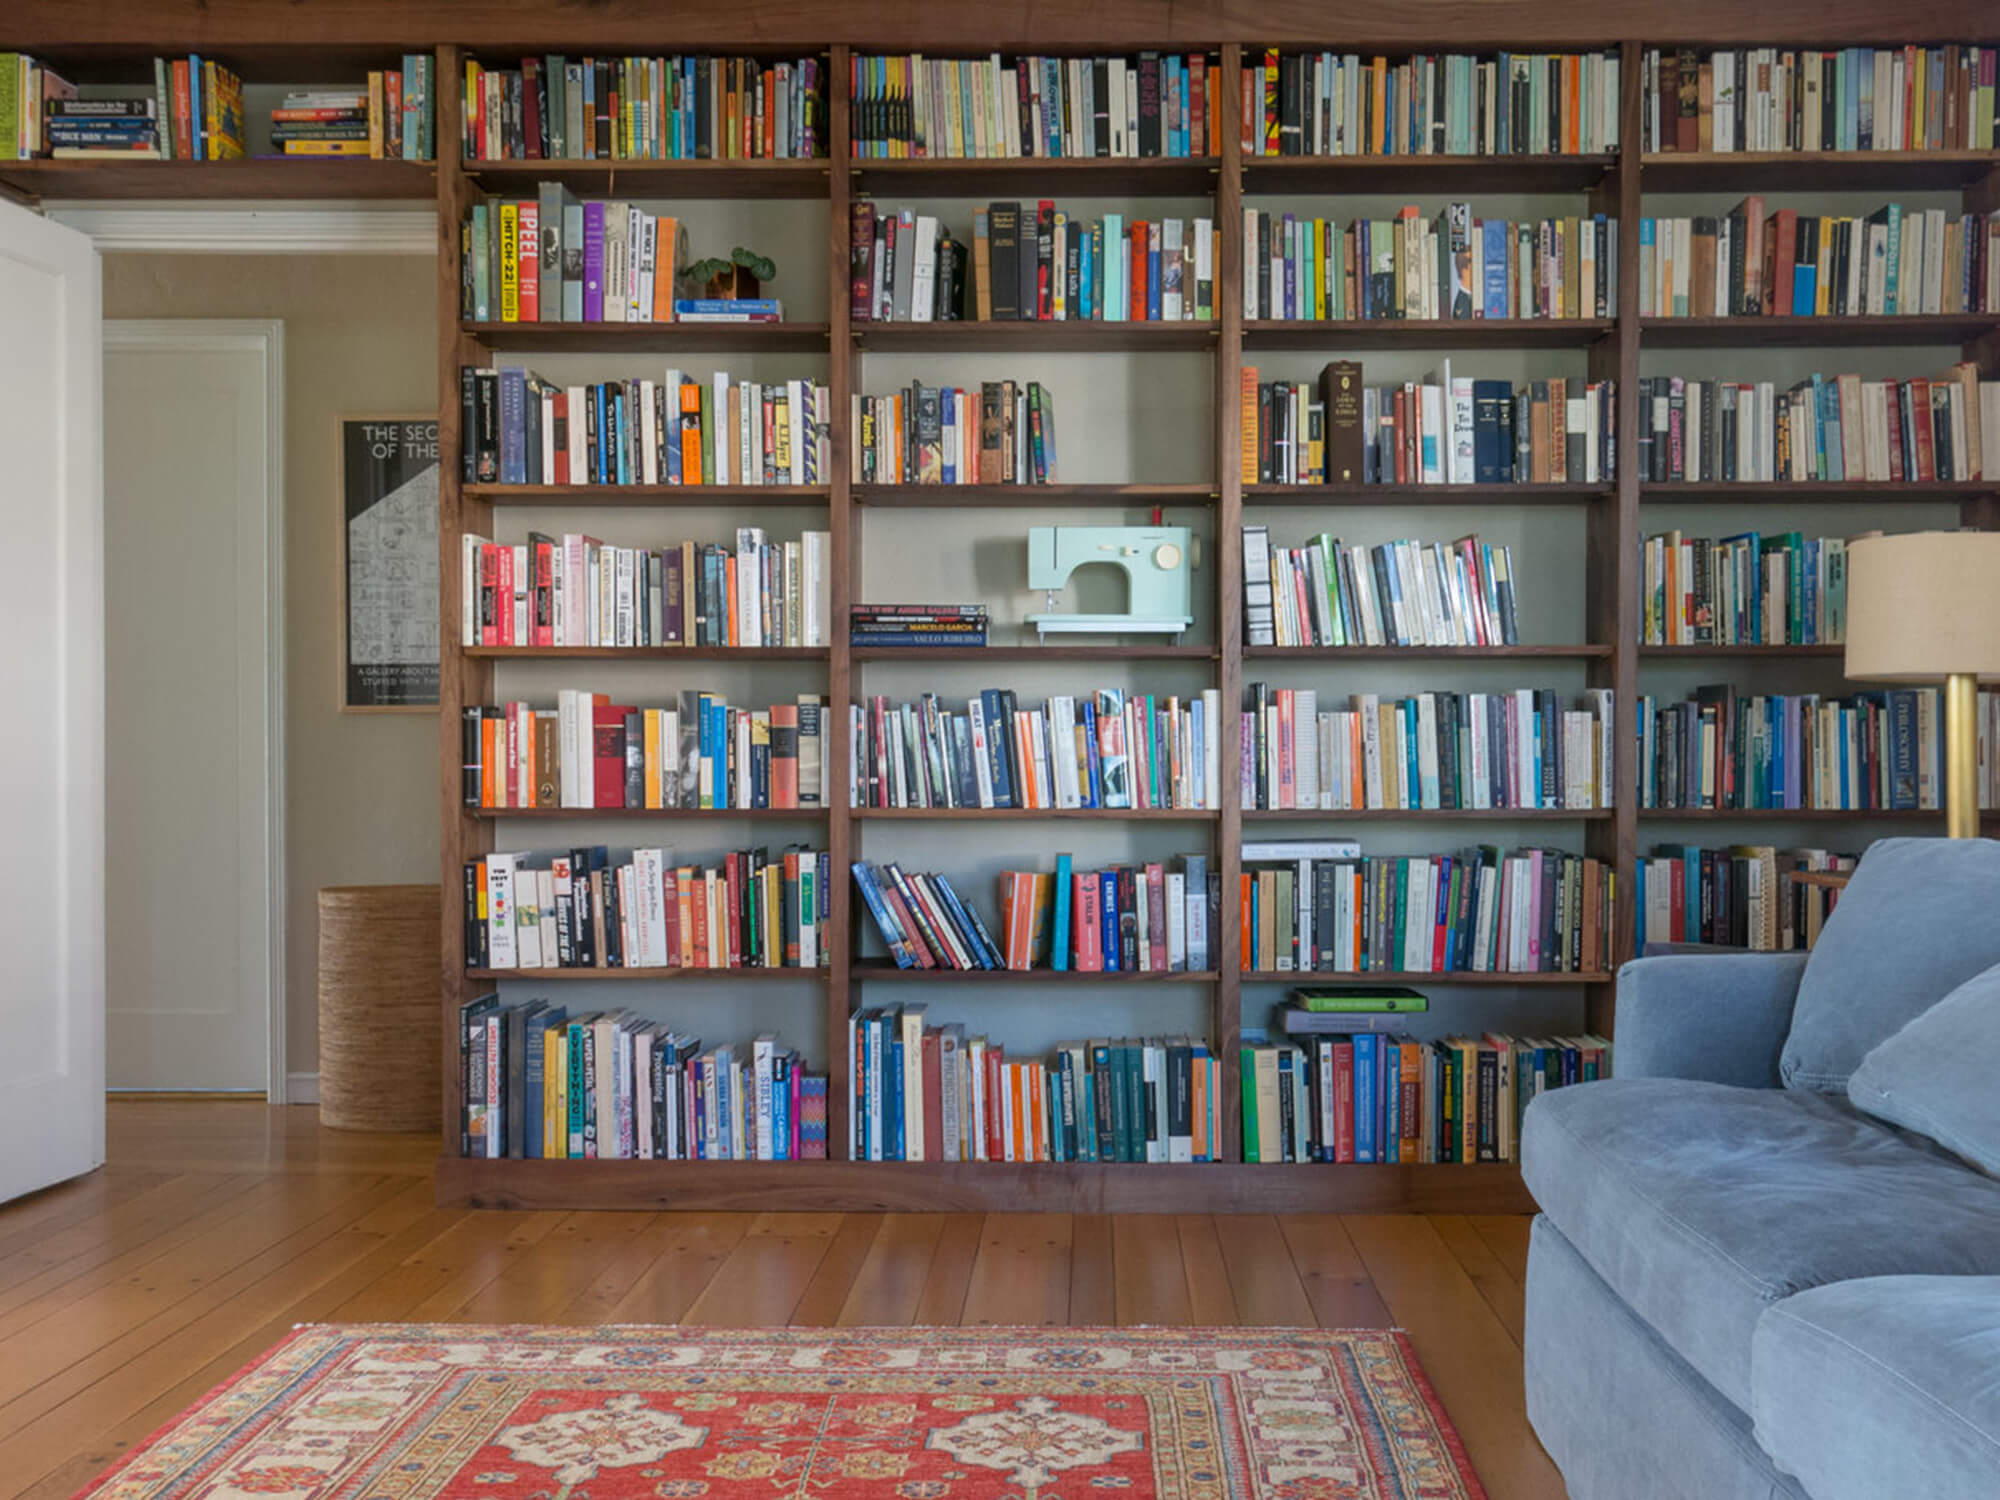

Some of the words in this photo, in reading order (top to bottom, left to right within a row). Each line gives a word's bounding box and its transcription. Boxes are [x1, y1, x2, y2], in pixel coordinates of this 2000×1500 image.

[503, 219, 514, 282] HITCH-22
[519, 217, 538, 261] PEEL
[362, 425, 398, 442] THE
[863, 414, 874, 448] Amis
[372, 442, 398, 460] OF
[405, 442, 439, 459] THE
[973, 703, 982, 729] HEAT
[1085, 895, 1094, 924] STALIN
[654, 1051, 664, 1103] Processing
[760, 1076, 770, 1118] SIBLEY
